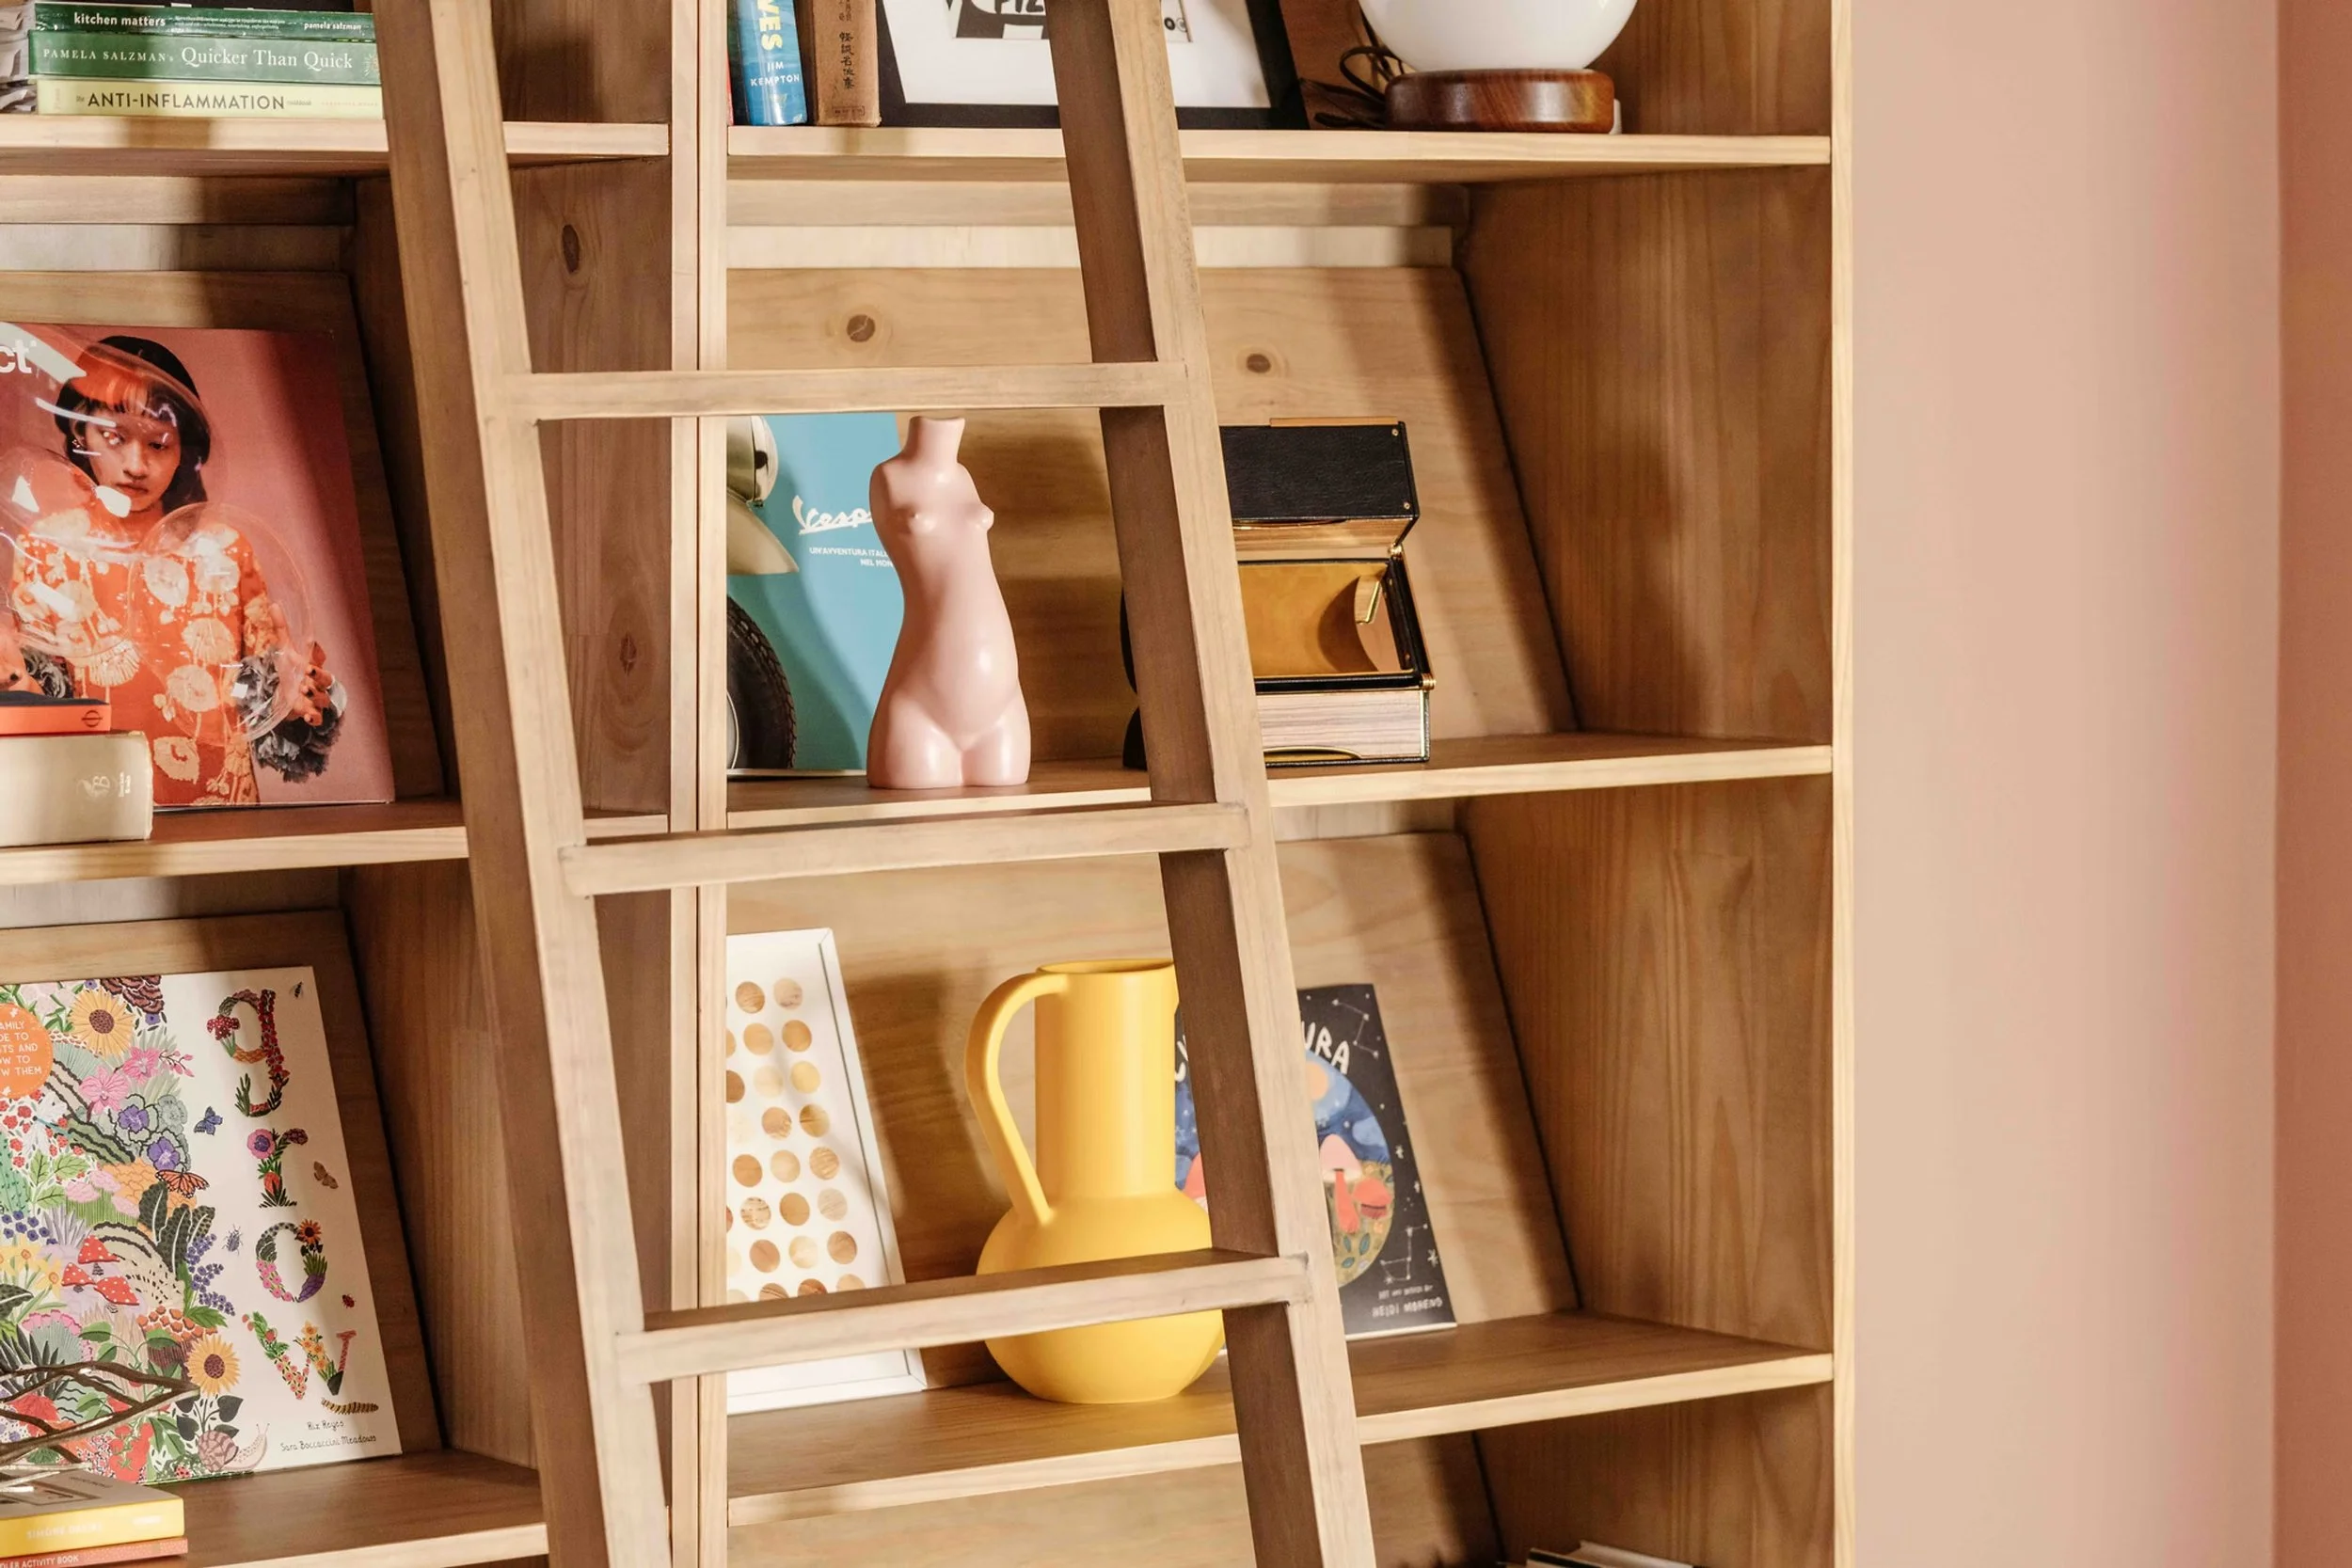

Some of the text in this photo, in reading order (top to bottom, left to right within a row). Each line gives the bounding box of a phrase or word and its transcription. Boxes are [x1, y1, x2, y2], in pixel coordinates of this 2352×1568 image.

[73, 12, 118, 25] kitchen
[121, 15, 166, 27] matters
[304, 22, 362, 31] pamela salzman
[43, 49, 97, 60] PAMELA
[182, 47, 247, 68] Quicker
[253, 49, 297, 67] Than
[304, 52, 353, 71] Quick
[767, 61, 784, 72] JIM
[751, 74, 800, 87] KEMPTON
[87, 92, 285, 110] ANTI-INFLAMMATION
[792, 495, 873, 534] Vesp
[876, 560, 894, 568] MON
[14, 1032, 29, 1041] TO
[19, 1042, 38, 1053] AND
[16, 1054, 31, 1064] TO
[15, 1066, 42, 1076] THEM
[1373, 1297, 1443, 1319] HEIDI MORENO
[322, 1419, 344, 1432] Reyes
[280, 1442, 298, 1451] Sara
[22, 1558, 56, 1568] ACTIVITY
[57, 1554, 80, 1565] BOOK
